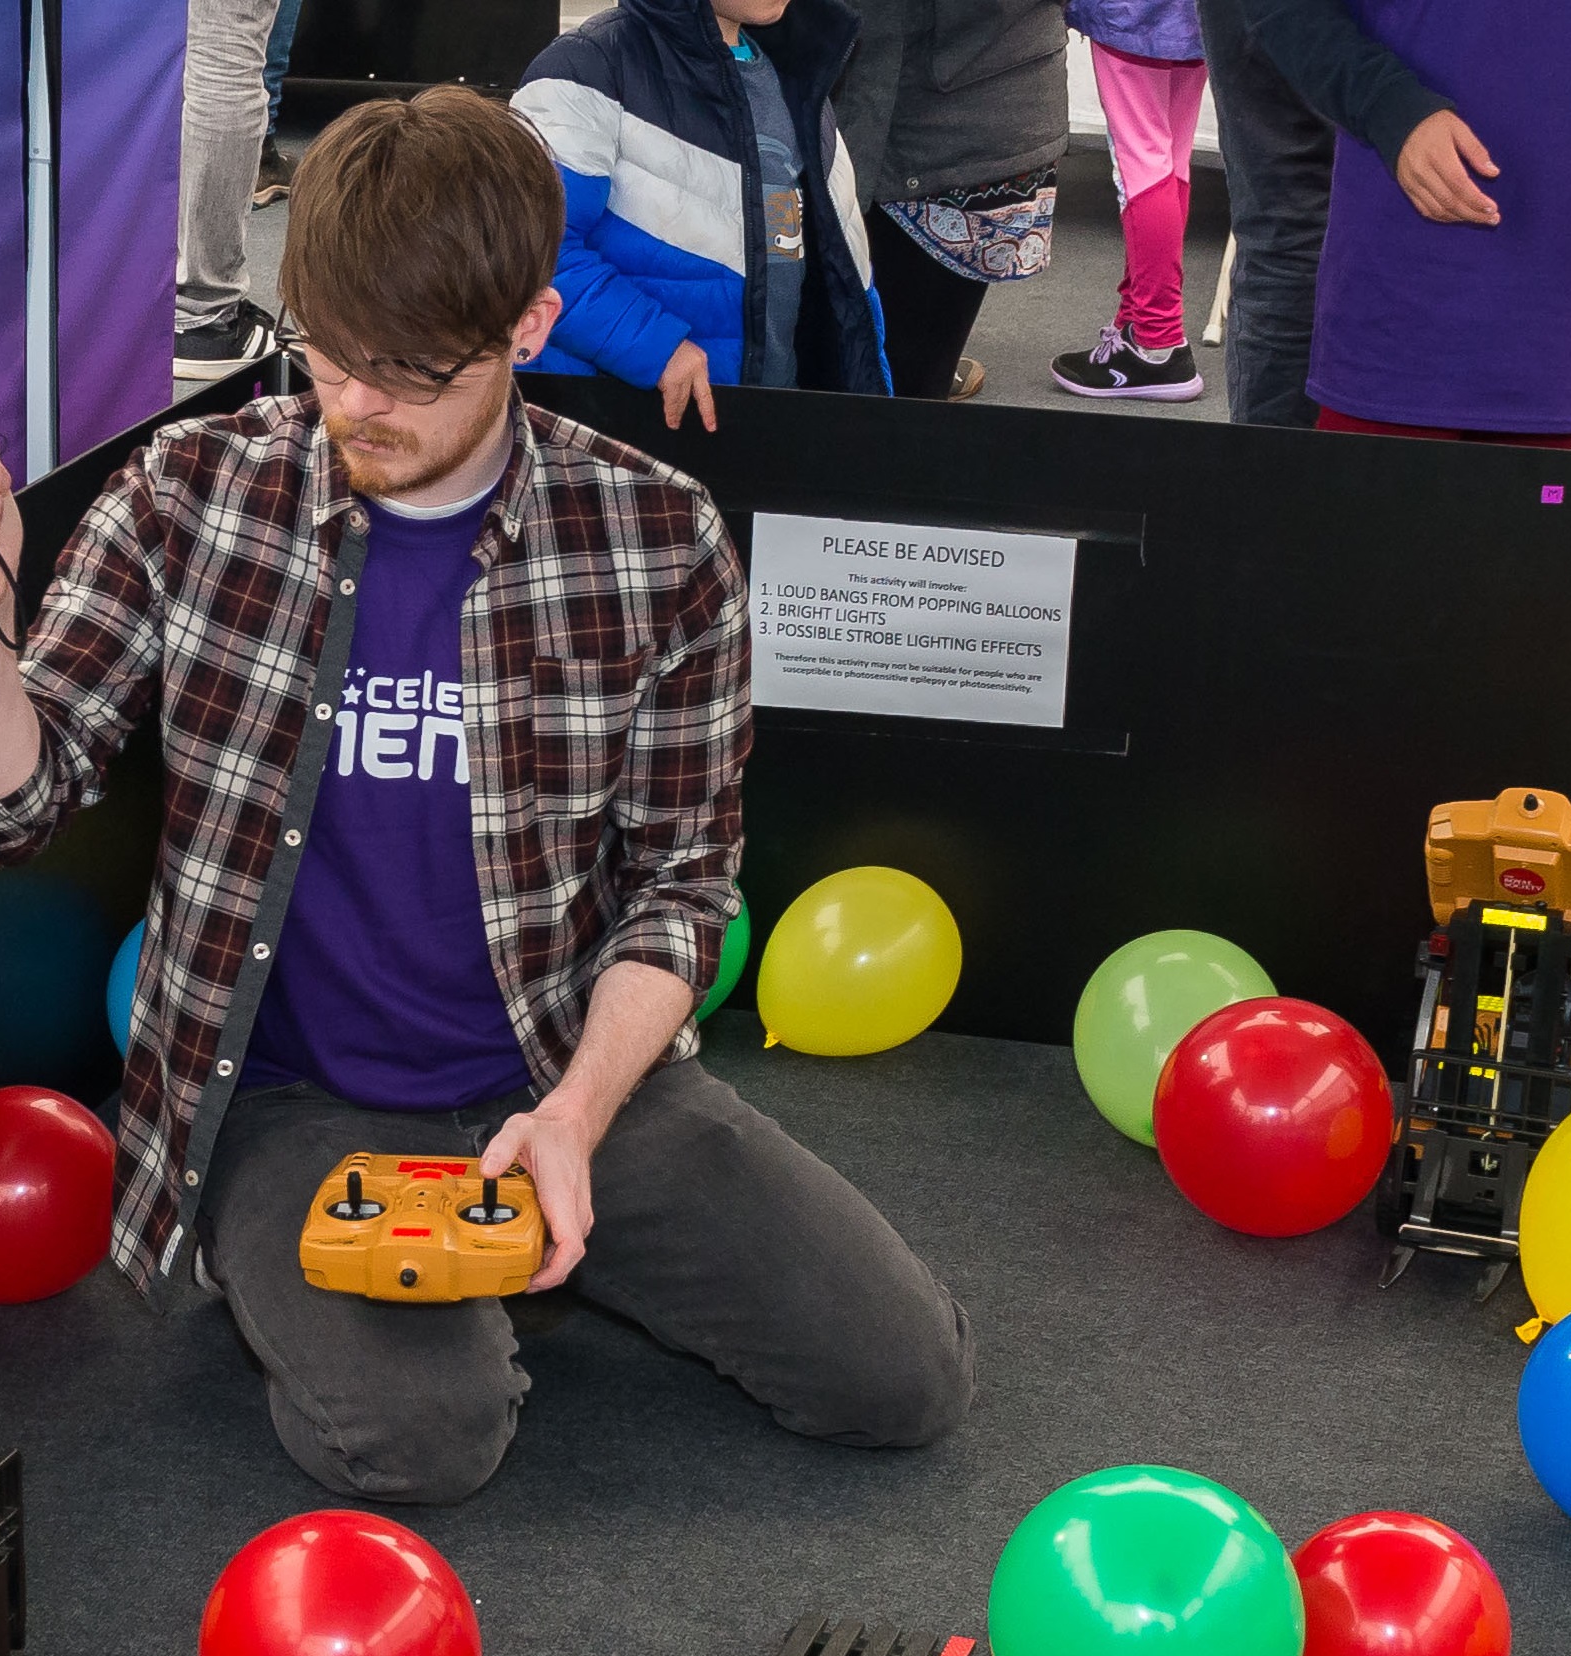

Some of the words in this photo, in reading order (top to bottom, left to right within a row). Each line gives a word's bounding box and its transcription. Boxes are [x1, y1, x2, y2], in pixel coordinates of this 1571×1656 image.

[823, 537, 890, 558] PLEASE
[895, 543, 918, 560] BE
[922, 546, 1005, 567] ADVISED
[848, 573, 867, 584] This
[870, 576, 906, 588] activity
[908, 579, 926, 588] will
[929, 581, 968, 592] involve:
[760, 602, 772, 615] 2.
[778, 604, 831, 620] BRIGHT
[836, 609, 886, 625] LIGHTS
[761, 583, 772, 596] 1.
[777, 585, 816, 600] LOUD
[820, 588, 868, 604] BANGS
[872, 593, 914, 608] FROM
[918, 597, 982, 615] POPPING
[986, 603, 1061, 621] BALLOONS
[759, 621, 771, 635] 3.
[777, 623, 843, 641] POSSIBLE
[847, 629, 902, 646] STROBE
[907, 634, 977, 651] LIGHTING
[981, 640, 1042, 657] EFFECTS
[775, 652, 816, 663] Therefore
[819, 656, 835, 664] this
[837, 658, 869, 668] activity
[871, 661, 890, 670] may
[892, 662, 907, 670] not
[909, 663, 920, 672] be
[922, 665, 956, 674] suitable
[959, 667, 972, 675] for
[974, 670, 1004, 679] people
[1006, 671, 1025, 680] who
[783, 666, 831, 676] susceptible
[845, 670, 908, 682] photosensitive
[910, 676, 946, 687] epilepsy
